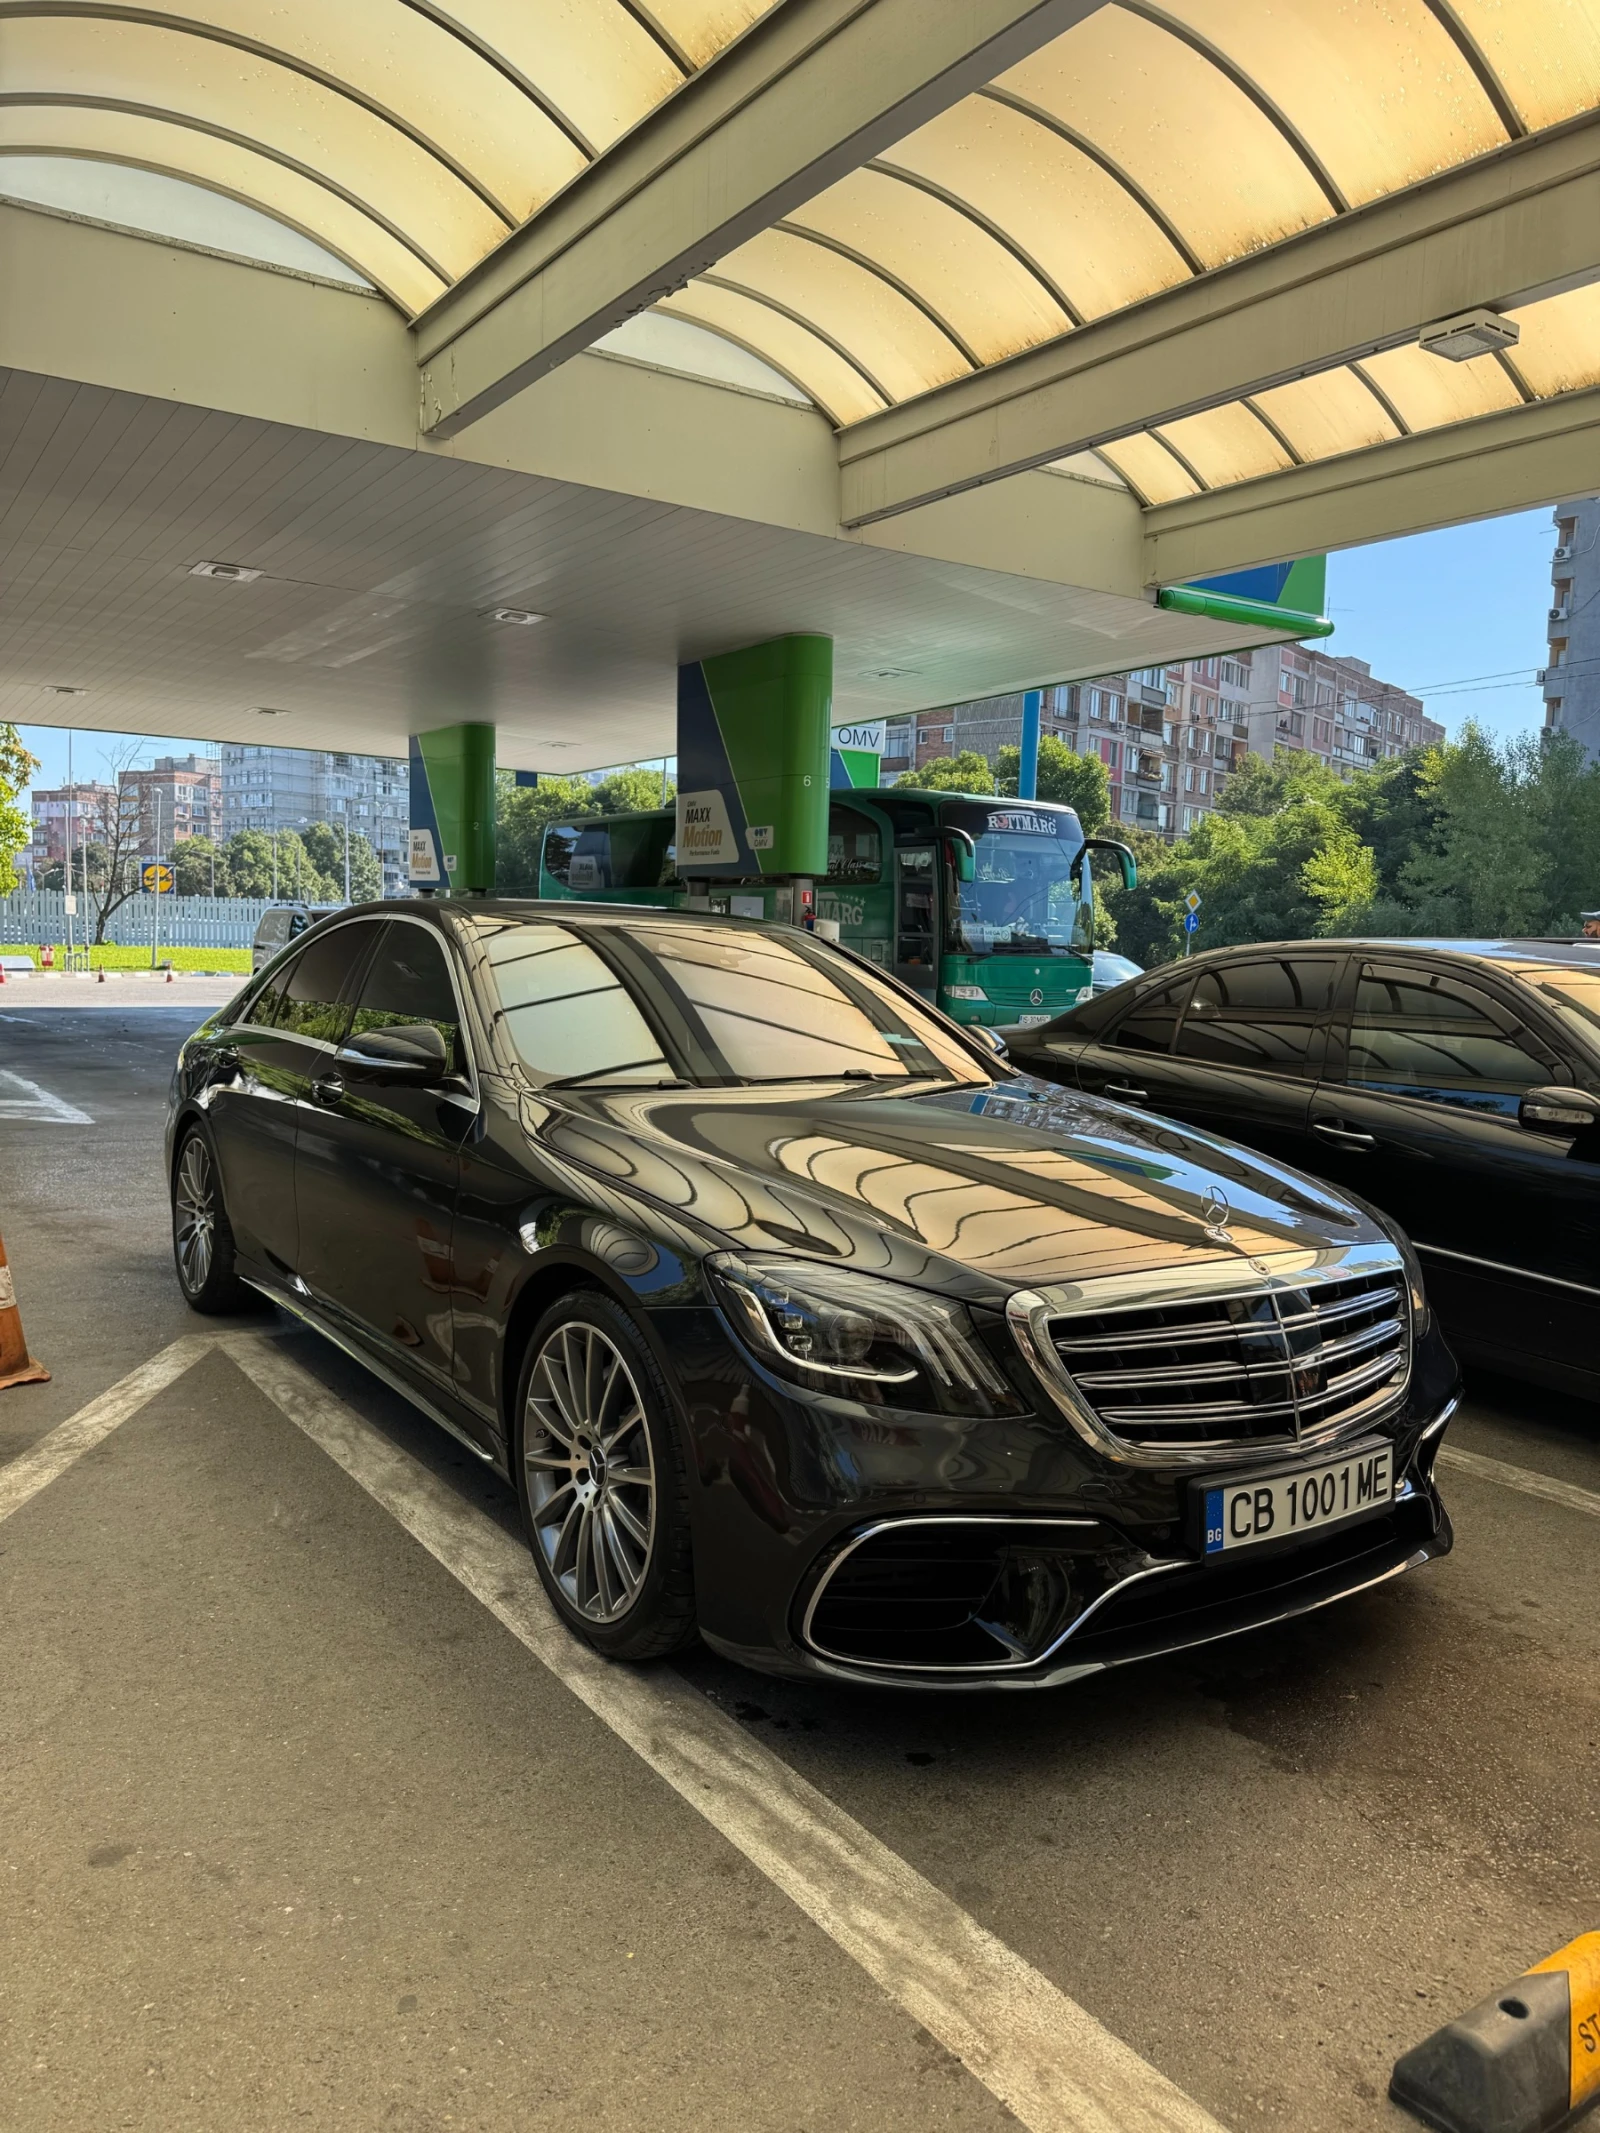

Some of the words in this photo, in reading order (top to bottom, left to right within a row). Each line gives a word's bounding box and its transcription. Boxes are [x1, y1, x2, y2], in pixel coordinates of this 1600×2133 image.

[838, 727, 880, 748] OMV
[803, 775, 812, 787] 6
[685, 807, 711, 824] MAXX
[473, 821, 479, 831] 2
[682, 824, 722, 848] Motion
[754, 839, 768, 848] OMV
[818, 900, 864, 926] MARG
[1230, 1487, 1275, 1539] CB
[1287, 1466, 1350, 1526] 1001
[1357, 1453, 1388, 1505] ME
[1207, 1528, 1222, 1544] BG
[1578, 2013, 1600, 2054] ST
